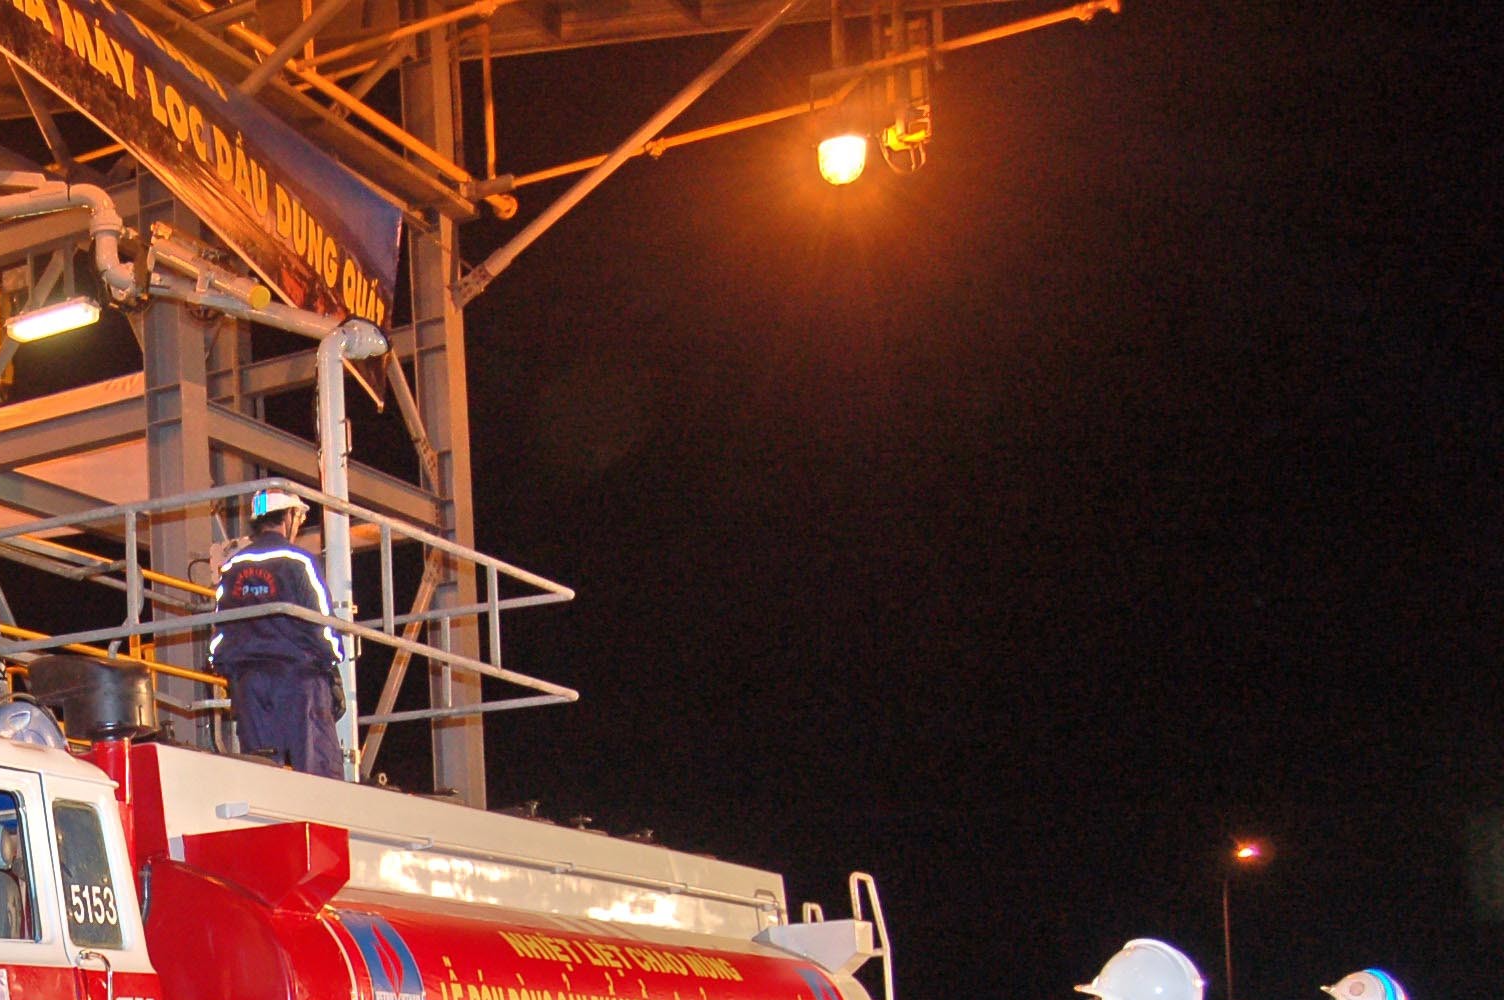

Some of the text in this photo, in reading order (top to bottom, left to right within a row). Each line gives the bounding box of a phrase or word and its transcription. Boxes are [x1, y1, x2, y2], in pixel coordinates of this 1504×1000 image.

[144, 66, 208, 162] LỌC
[213, 125, 269, 217] DẦU
[275, 183, 338, 288] DUNG
[70, 884, 118, 926] 5153
[499, 930, 582, 972] NHIỆT
[573, 939, 632, 977] LIỆT
